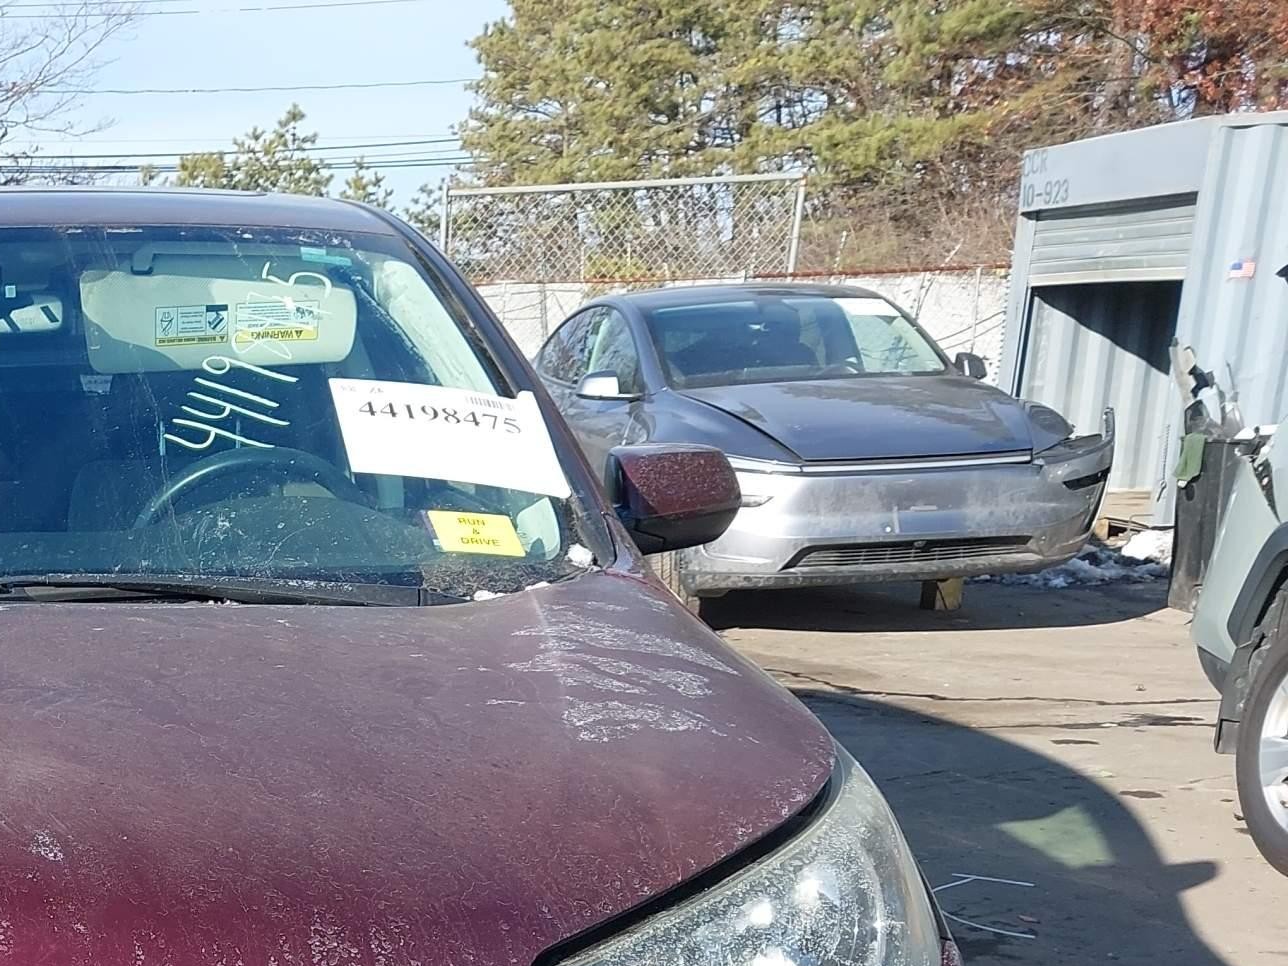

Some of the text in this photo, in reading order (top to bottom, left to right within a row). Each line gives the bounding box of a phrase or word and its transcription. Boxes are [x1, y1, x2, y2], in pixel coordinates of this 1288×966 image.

[1022, 179, 1070, 208] 10-923
[359, 401, 521, 434] 44198475
[457, 517, 486, 526] RUN
[461, 537, 501, 547] DRIVE
